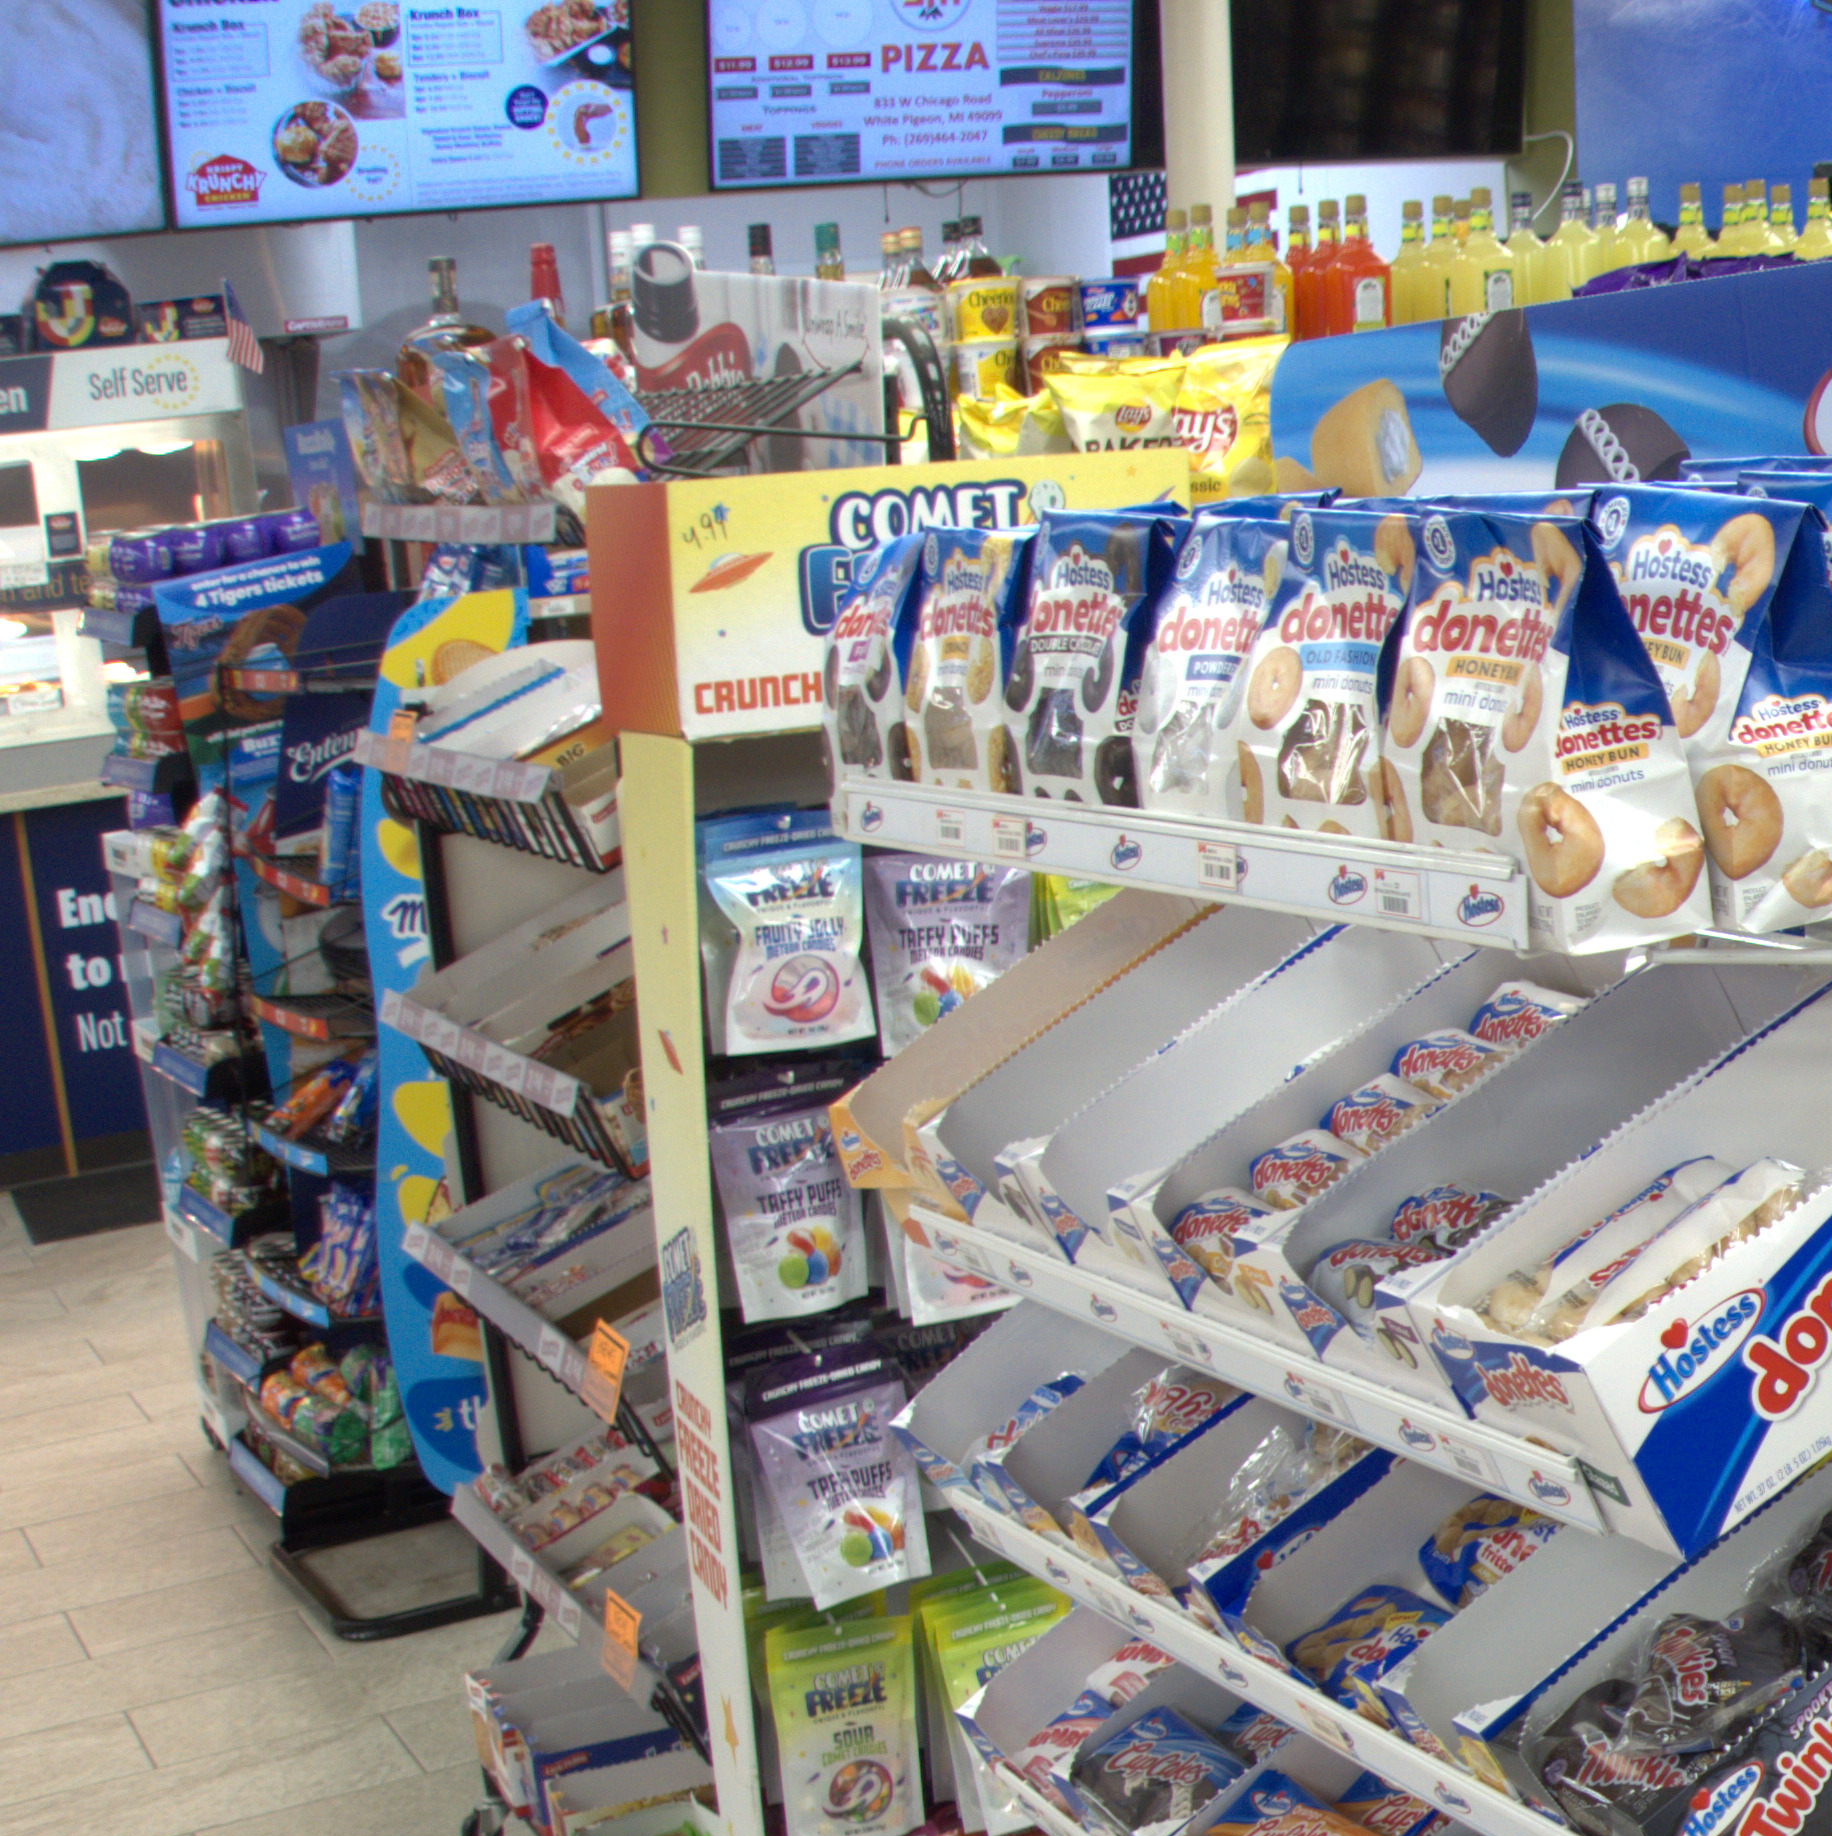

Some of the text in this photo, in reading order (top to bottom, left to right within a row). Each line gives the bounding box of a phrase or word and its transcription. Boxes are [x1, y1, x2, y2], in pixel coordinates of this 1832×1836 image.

[881, 42, 989, 73] PIZZA
[900, 97, 912, 108] W
[915, 95, 960, 111] Chicago
[964, 93, 992, 105] Road
[865, 115, 899, 127] White
[949, 112, 964, 123] MI
[186, 169, 267, 192] KRUNCHY
[89, 365, 188, 401] Self Serve
[838, 485, 1020, 546] COMET
[208, 581, 260, 609] Tigers
[266, 568, 324, 592] tickets
[1328, 560, 1384, 590] Hostess
[1314, 675, 1373, 693] mini donuts
[1764, 739, 1805, 756] HONEY
[1767, 758, 1796, 776] mini
[910, 862, 974, 882] COMET
[755, 926, 800, 946] FRUITY
[899, 923, 999, 946] TAFFY PUFFS
[68, 951, 111, 989] to
[76, 1012, 127, 1051] Not
[756, 1179, 842, 1214] TAFFY PUFFS
[1646, 1295, 1756, 1402] Hostess
[686, 1482, 720, 1553] DRIED
[813, 1671, 866, 1695] COMET
[806, 1687, 887, 1715] FREEZE
[833, 1727, 876, 1750] SOUR
[1106, 1741, 1207, 1786] CupCakes
